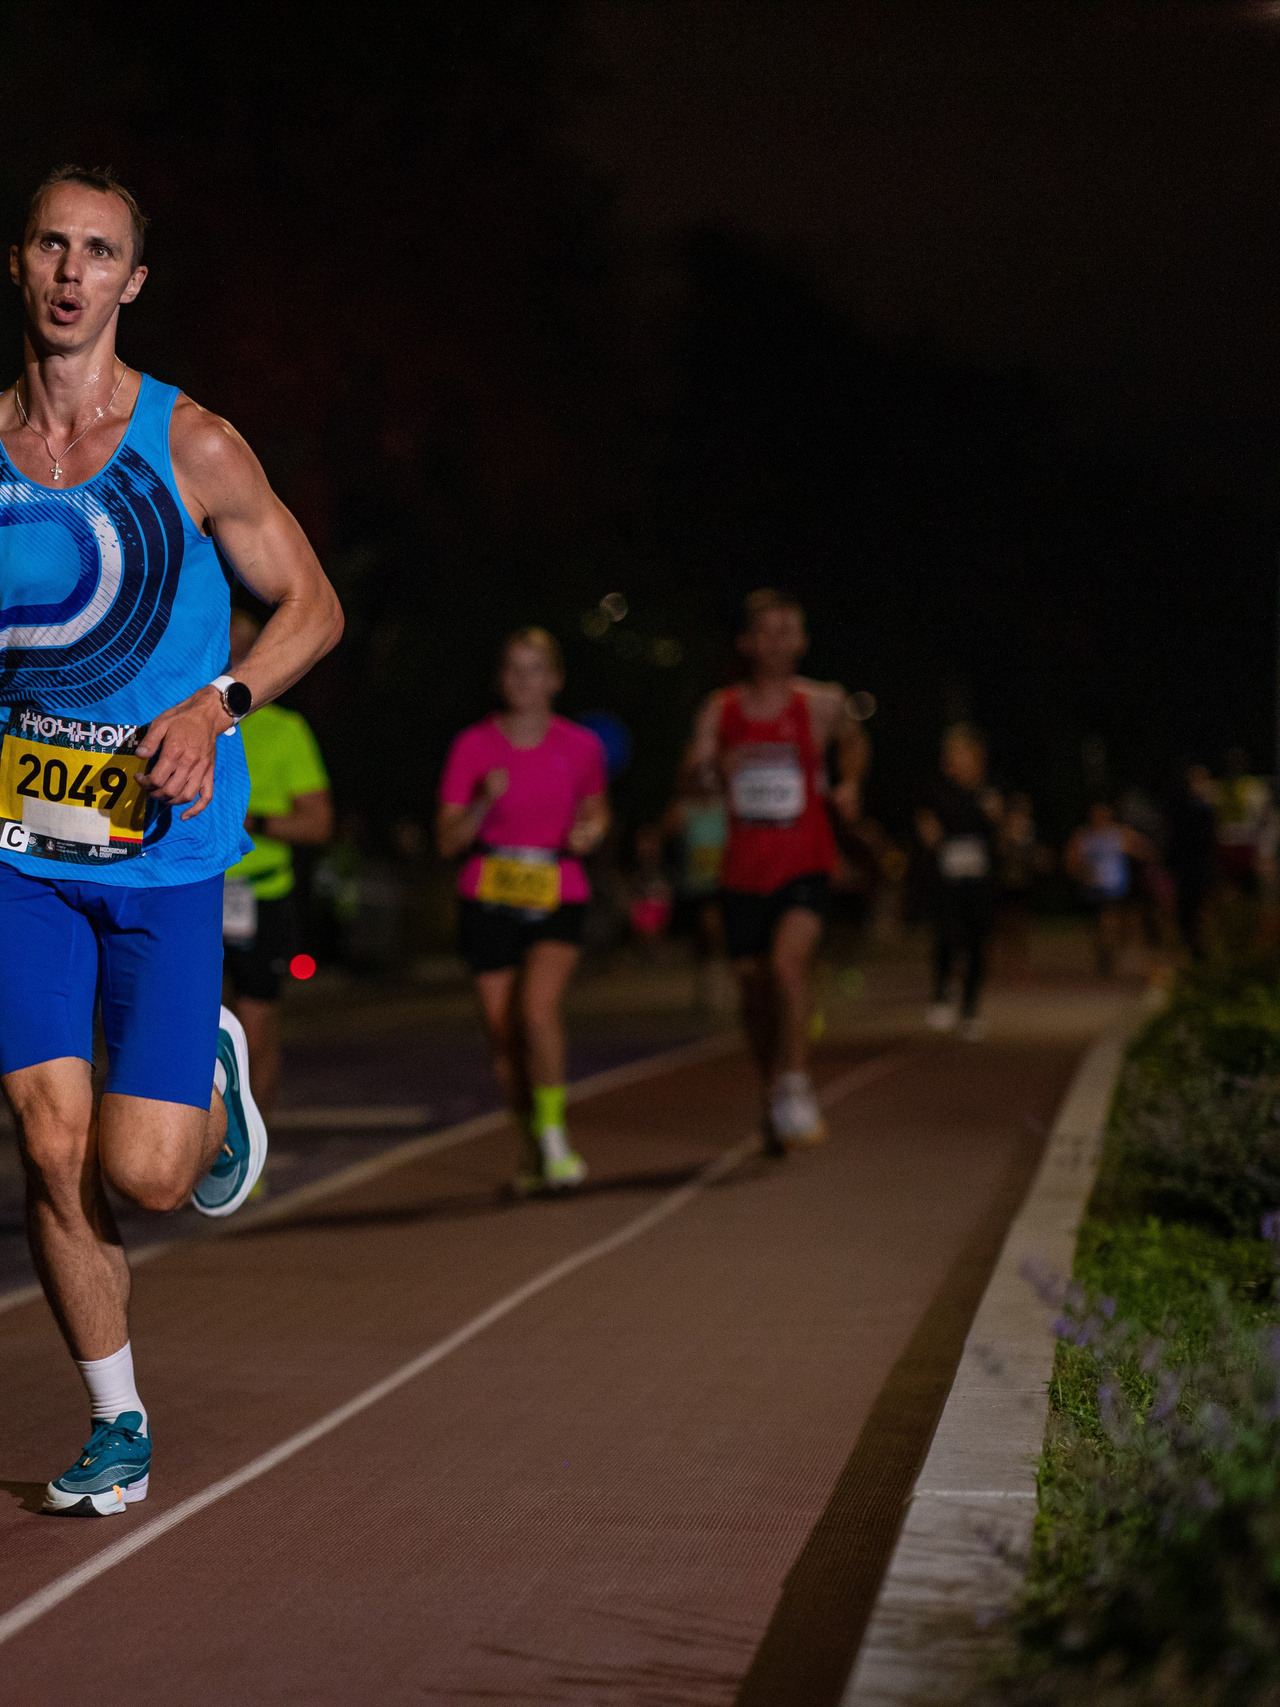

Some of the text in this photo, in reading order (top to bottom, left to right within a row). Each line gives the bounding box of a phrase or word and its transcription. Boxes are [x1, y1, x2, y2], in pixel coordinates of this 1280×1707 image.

[10, 727, 49, 744] 2024
[69, 742, 117, 755] ЗАБЕГ
[17, 753, 127, 810] 2049
